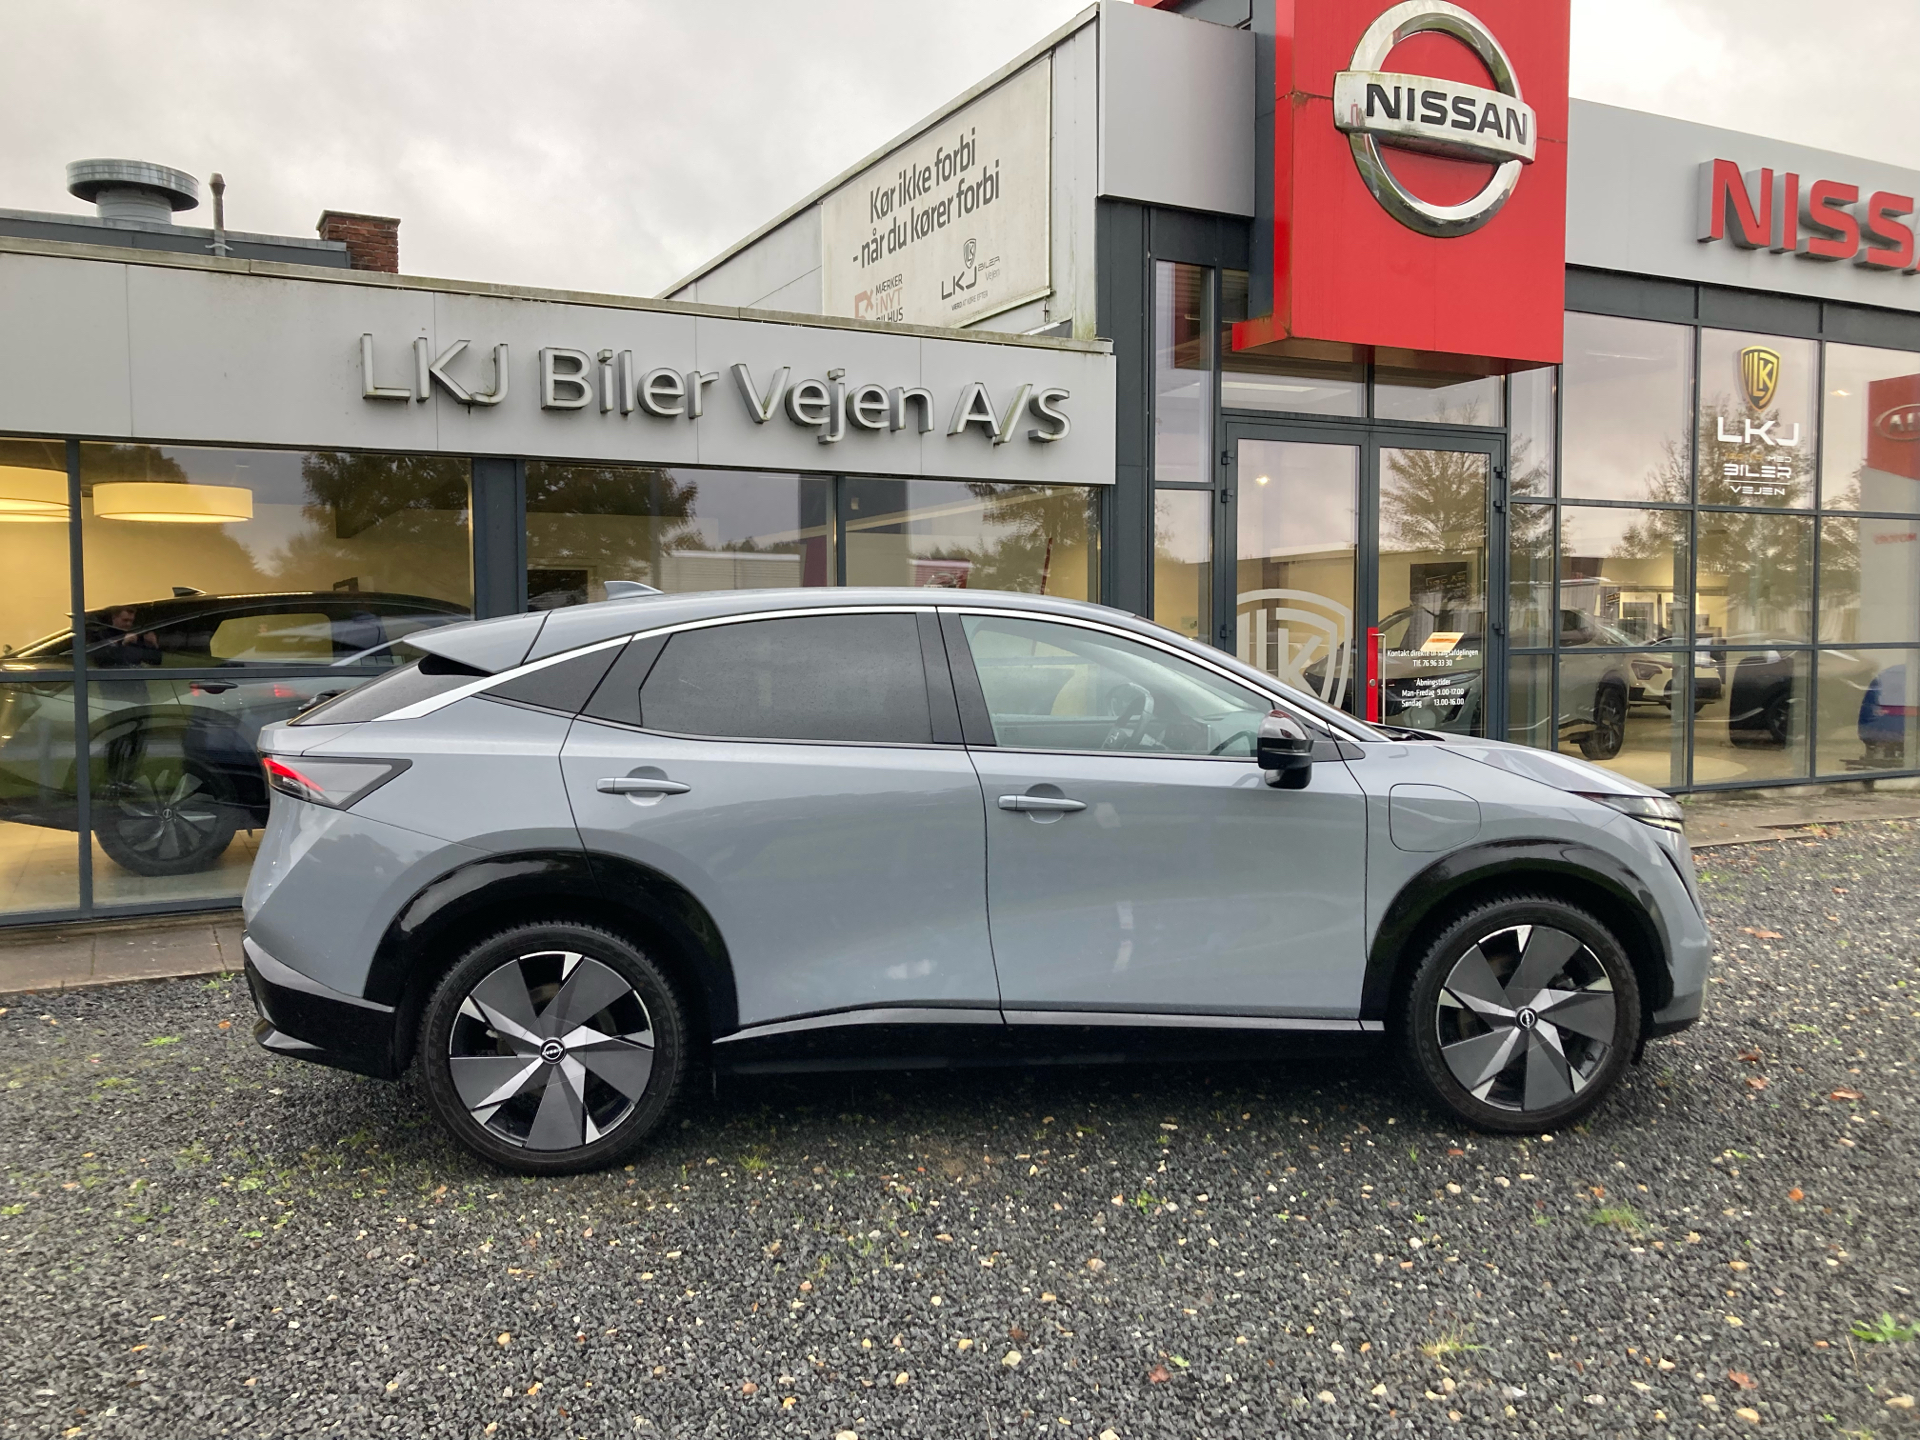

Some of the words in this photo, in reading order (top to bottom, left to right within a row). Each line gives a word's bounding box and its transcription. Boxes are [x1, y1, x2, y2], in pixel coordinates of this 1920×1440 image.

[1366, 83, 1527, 145] NISSAN
[870, 186, 896, 223] Kør
[898, 163, 931, 208] ikke
[934, 126, 976, 186] forbi
[887, 216, 907, 255] du
[910, 195, 953, 243] kører
[956, 159, 1000, 219] forbi
[1699, 158, 1920, 275] NISS
[875, 273, 903, 296] MÆRKER
[941, 265, 977, 300] LKJ
[880, 286, 903, 313] NYT
[360, 332, 509, 407] LKJ
[539, 347, 719, 419] Biler
[730, 363, 935, 445] Vejen
[946, 381, 1072, 446] A/S
[1717, 416, 1800, 446] LKJ
[1723, 463, 1792, 479] BILER
[1730, 485, 1786, 496] VEJEN
[1387, 649, 1410, 657] Kontakt
[1402, 689, 1435, 697] Man-Fredag
[1416, 677, 1451, 687] Åbningstider
[1402, 700, 1422, 708] Søndag
